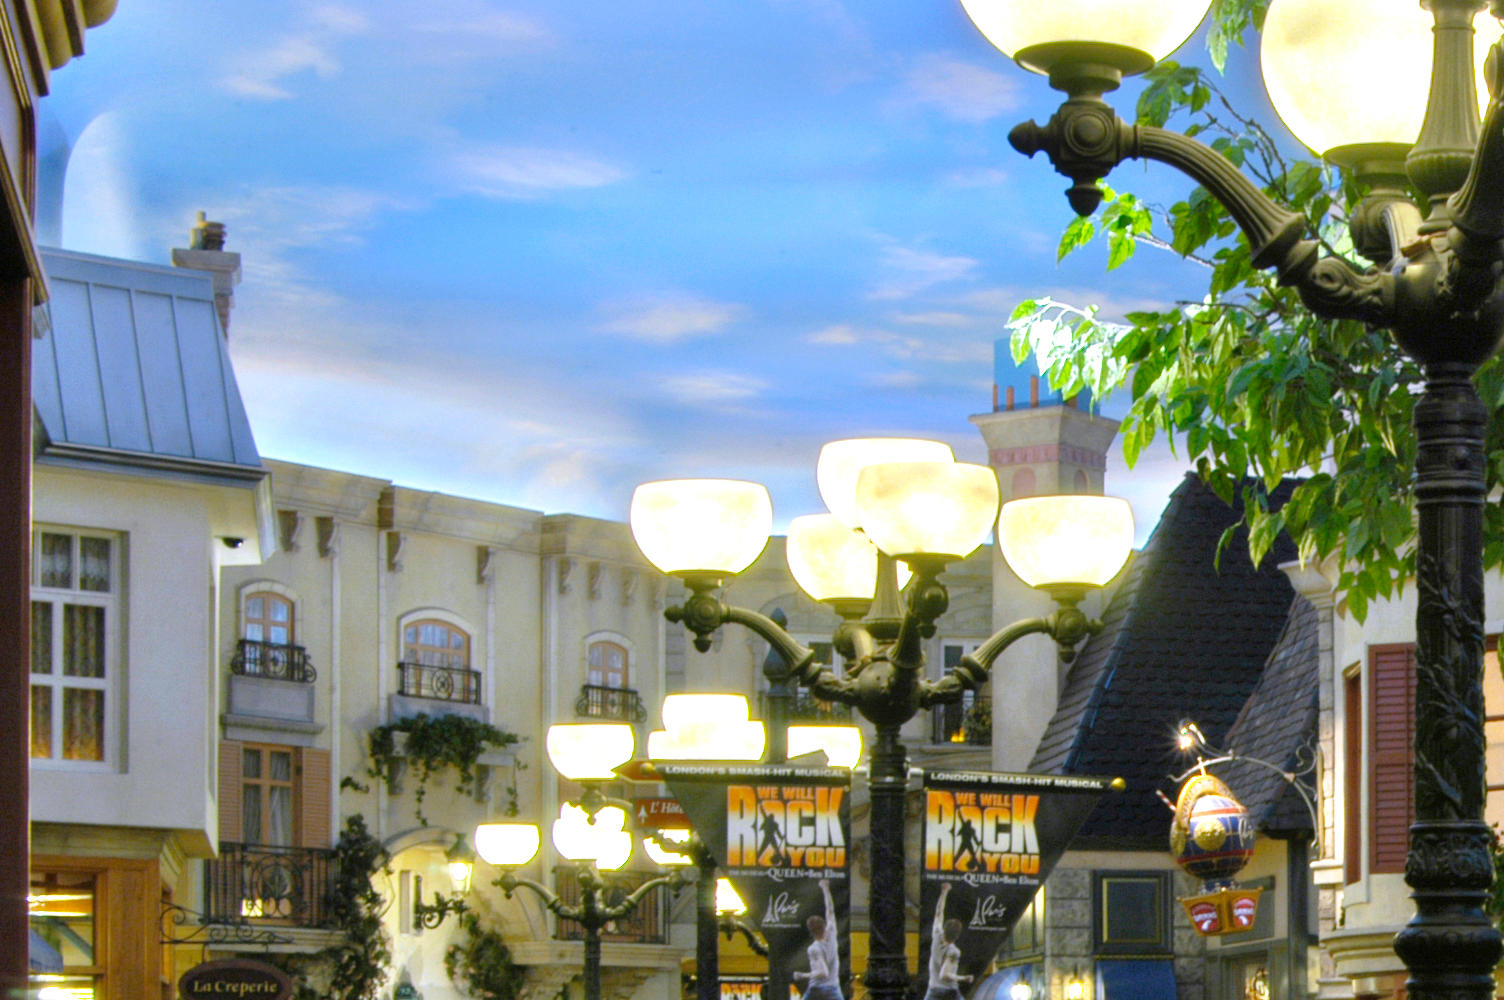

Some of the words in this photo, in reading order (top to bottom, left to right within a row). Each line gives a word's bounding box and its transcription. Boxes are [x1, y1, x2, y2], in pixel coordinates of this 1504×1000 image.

[665, 766, 725, 775] LONDON'S
[728, 767, 792, 777] SMASH-HIT
[794, 768, 847, 778] MUSICAL
[930, 772, 989, 783] LONDON'S
[991, 775, 1052, 786] SMASH-HIT
[1054, 778, 1103, 789] MUSICAL
[757, 786, 779, 800] WE
[783, 786, 815, 800] WILL
[955, 791, 977, 806] WE
[980, 793, 1011, 807] WILL
[727, 785, 846, 867] ROCK
[925, 790, 1040, 872] ROCK
[785, 847, 846, 868] YOU
[982, 853, 1040, 875] YOU
[767, 868, 804, 882] QUEEN
[964, 872, 1000, 887] QUEEN
[194, 981, 212, 992] La
